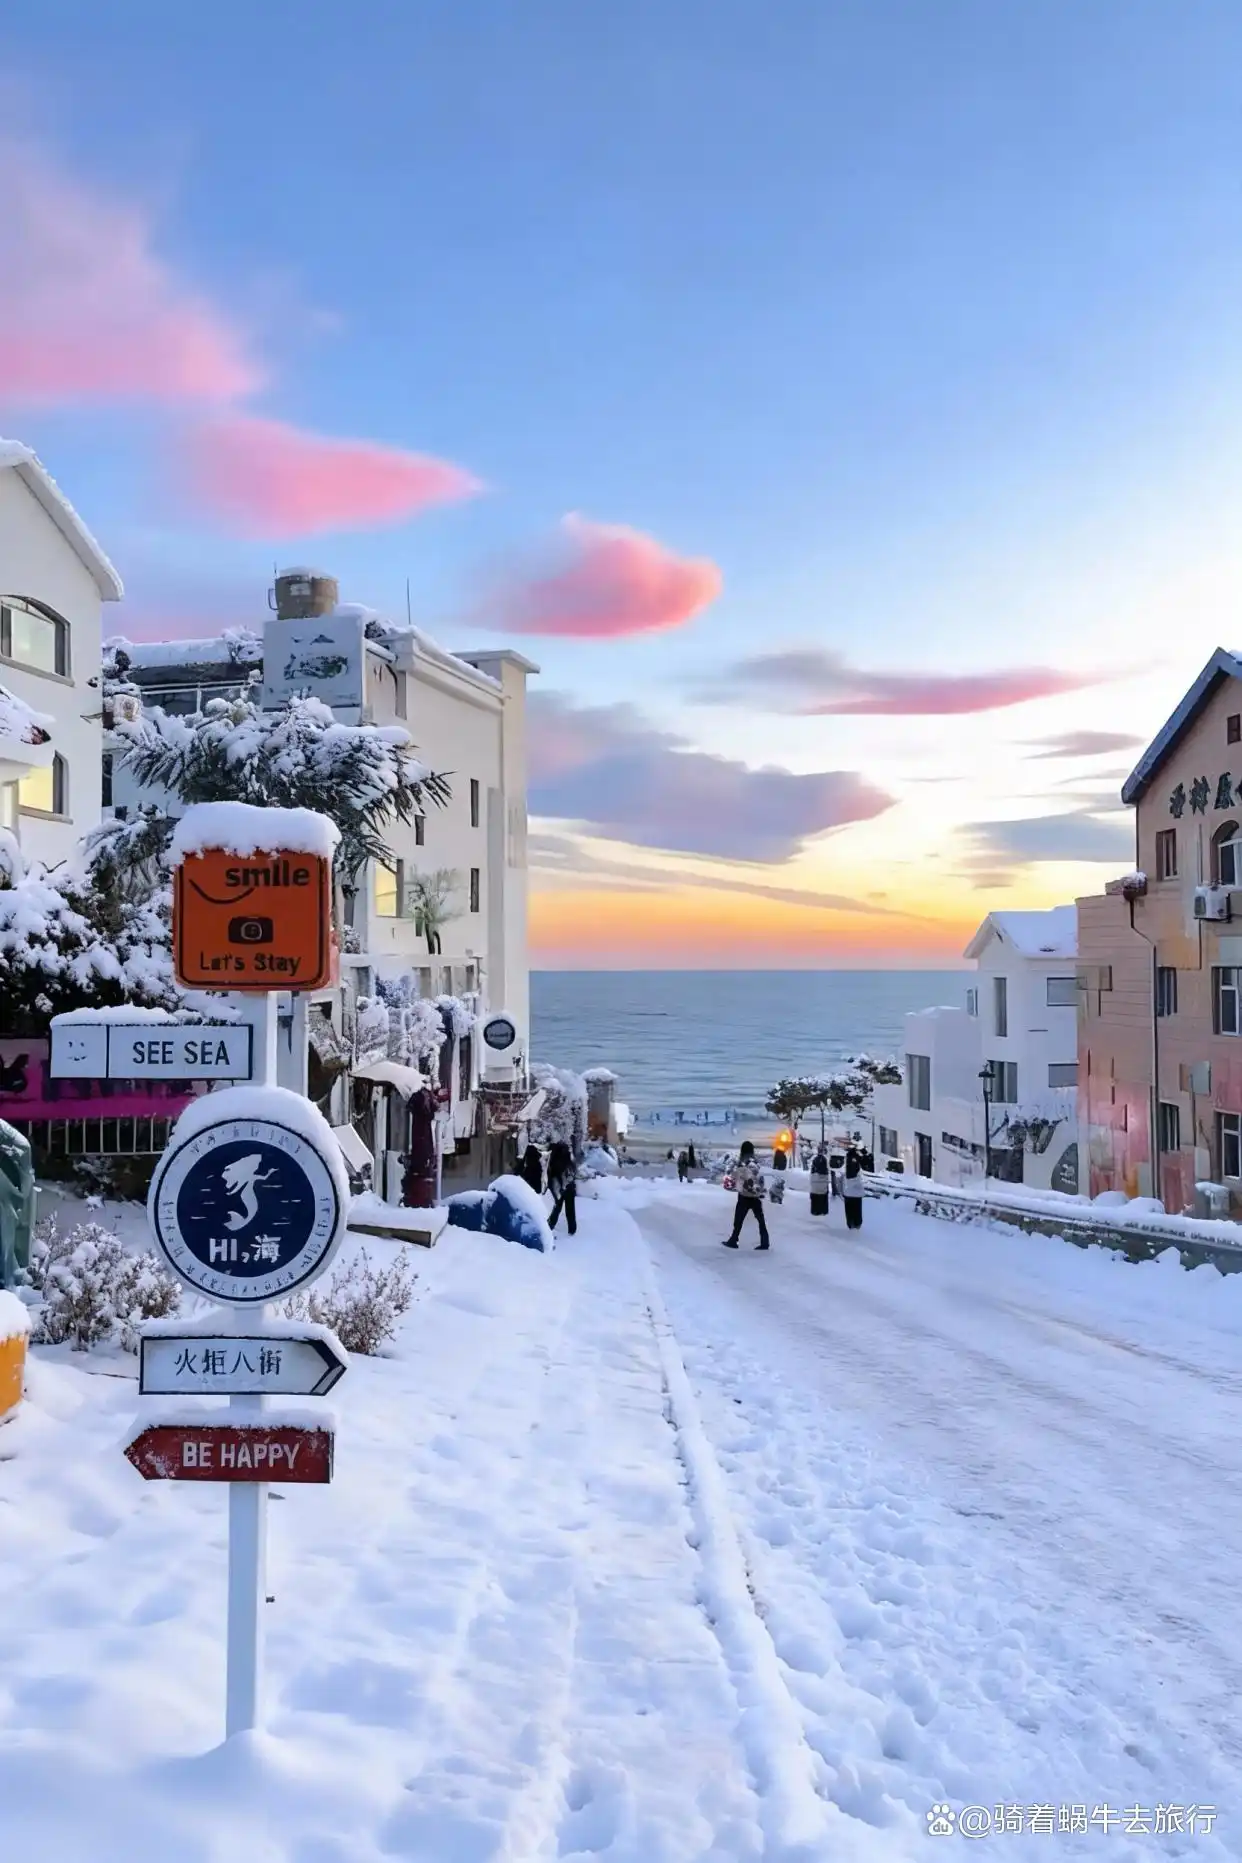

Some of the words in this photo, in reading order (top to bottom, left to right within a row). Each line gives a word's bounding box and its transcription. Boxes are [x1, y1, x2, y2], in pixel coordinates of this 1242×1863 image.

[225, 859, 310, 887] smile
[200, 951, 245, 971] Let's
[254, 952, 302, 976] Stay
[132, 1040, 174, 1064] SEE
[184, 1040, 230, 1065] SEA
[182, 1441, 214, 1467] BE
[220, 1441, 300, 1469] HAPPY
